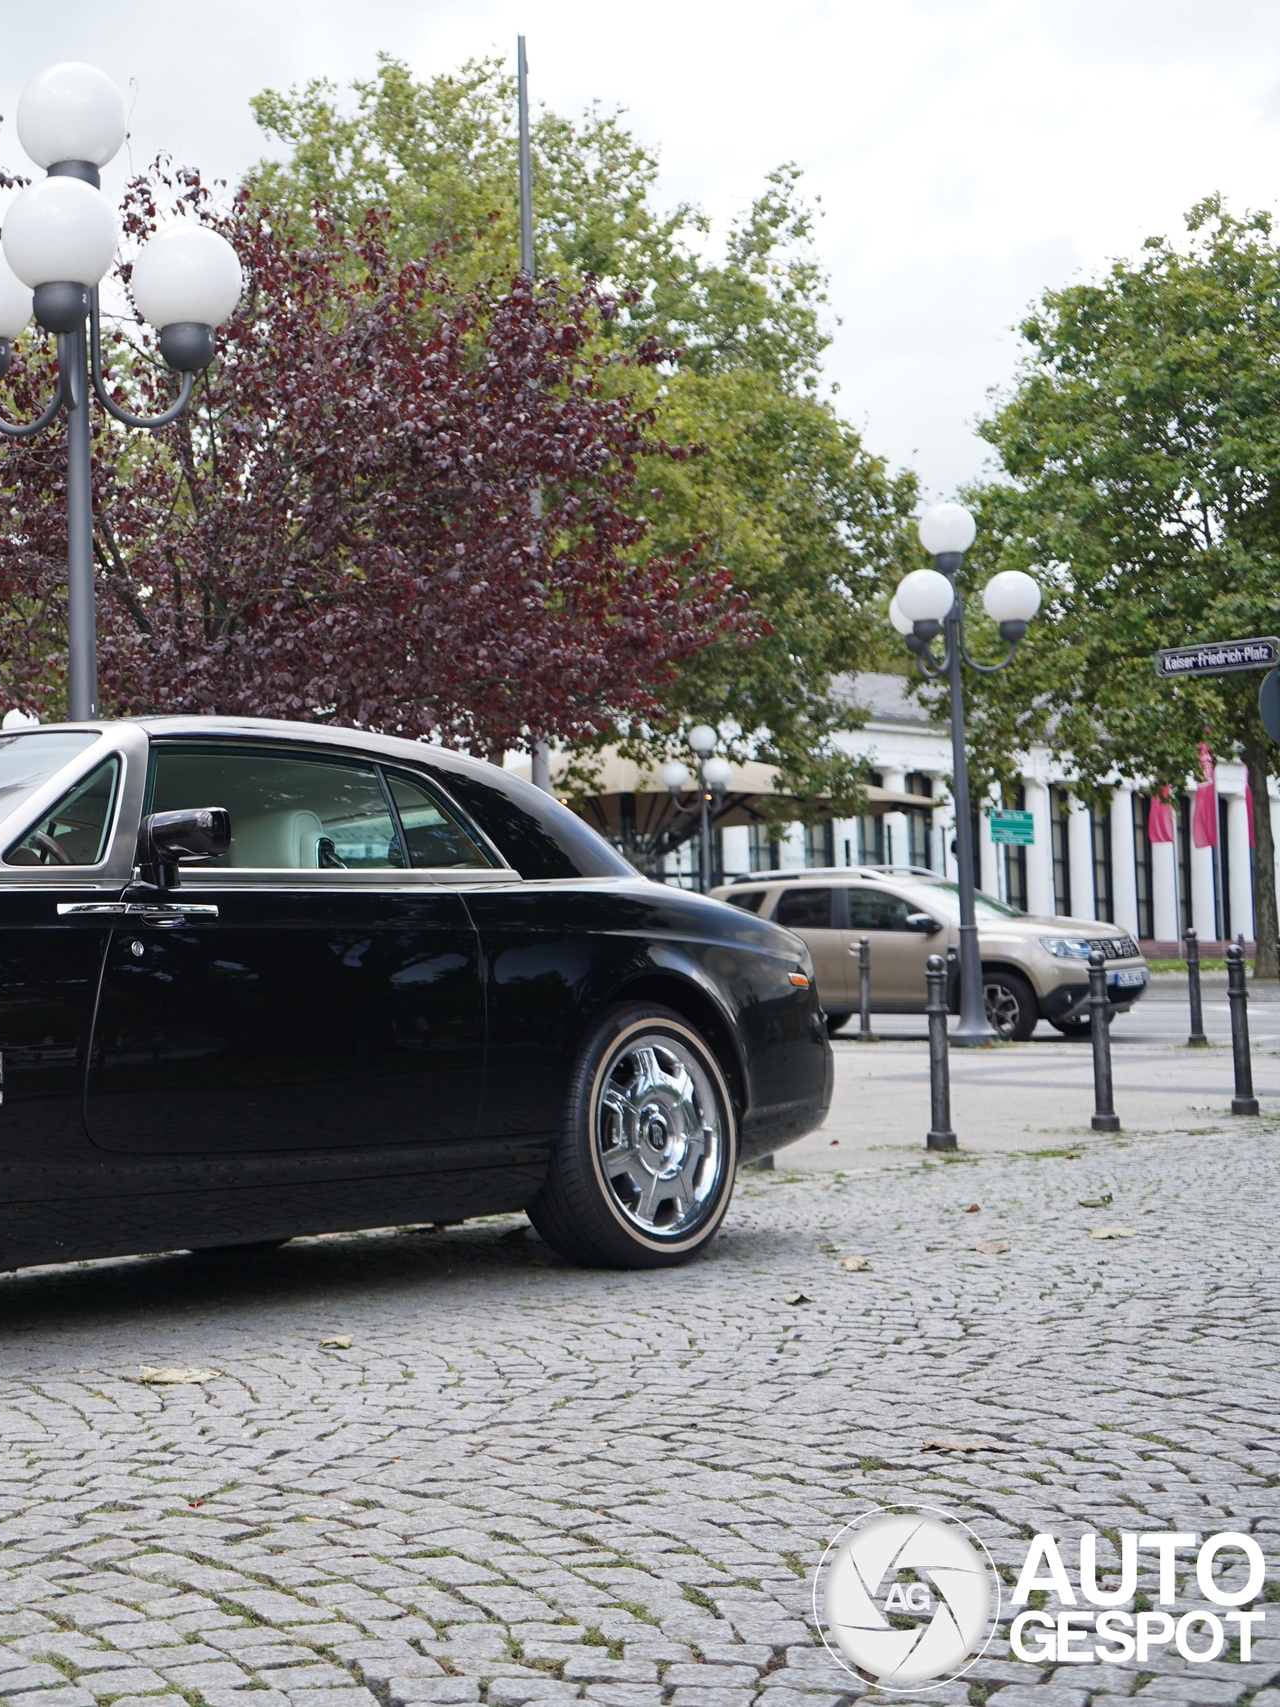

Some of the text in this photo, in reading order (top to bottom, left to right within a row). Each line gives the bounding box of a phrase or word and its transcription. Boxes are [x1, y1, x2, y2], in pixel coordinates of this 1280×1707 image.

[82, 293, 87, 304] 2
[0, 345, 6, 355] 3
[1164, 645, 1270, 671] Kaiser-Friedrich-Platz
